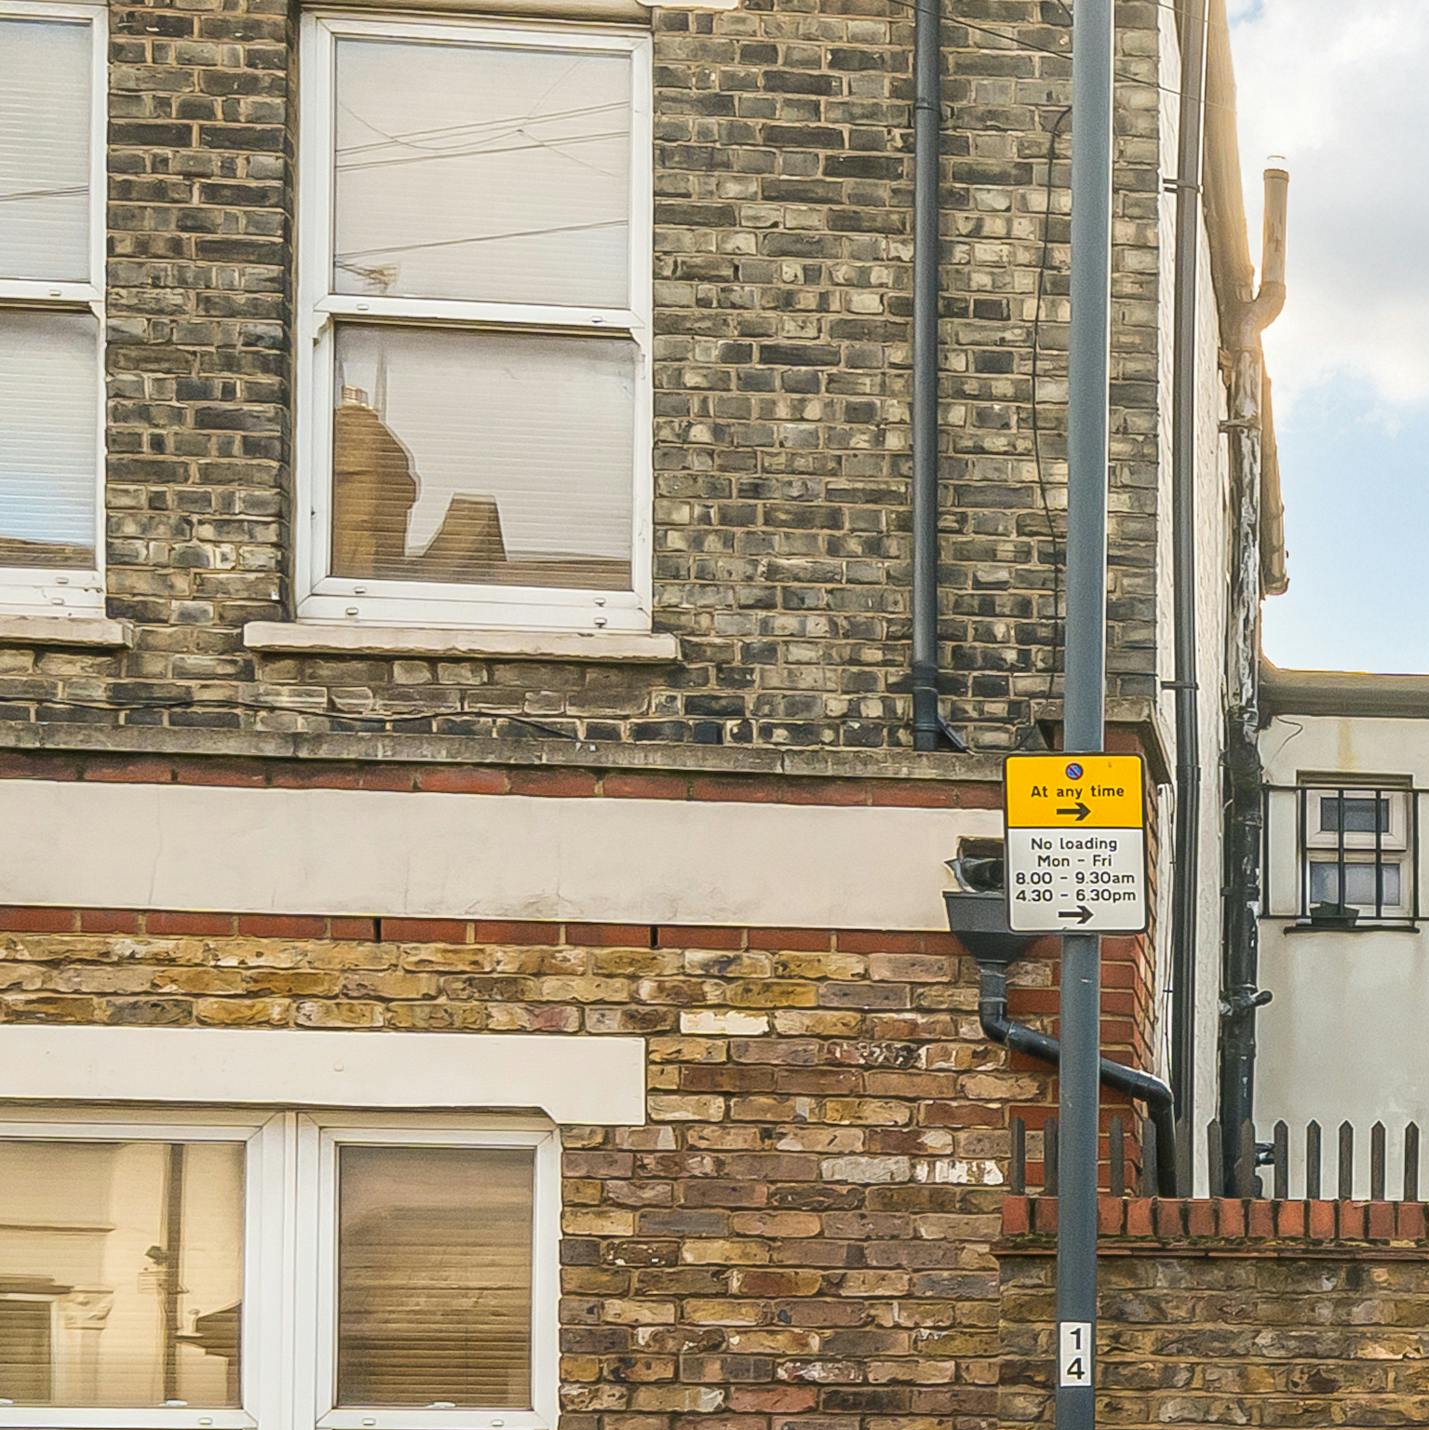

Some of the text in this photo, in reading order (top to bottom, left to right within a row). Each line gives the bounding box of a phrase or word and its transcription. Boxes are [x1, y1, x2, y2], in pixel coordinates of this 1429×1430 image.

[1031, 785, 1125, 799] At any time
[1031, 837, 1118, 852] No loading
[1037, 855, 1070, 868] Mon
[1093, 854, 1112, 867] Fri
[1015, 872, 1053, 885] 8.00
[1075, 871, 1135, 884] 9.30am
[1015, 889, 1053, 902] 4.30
[1076, 889, 1136, 904] 6.30pm
